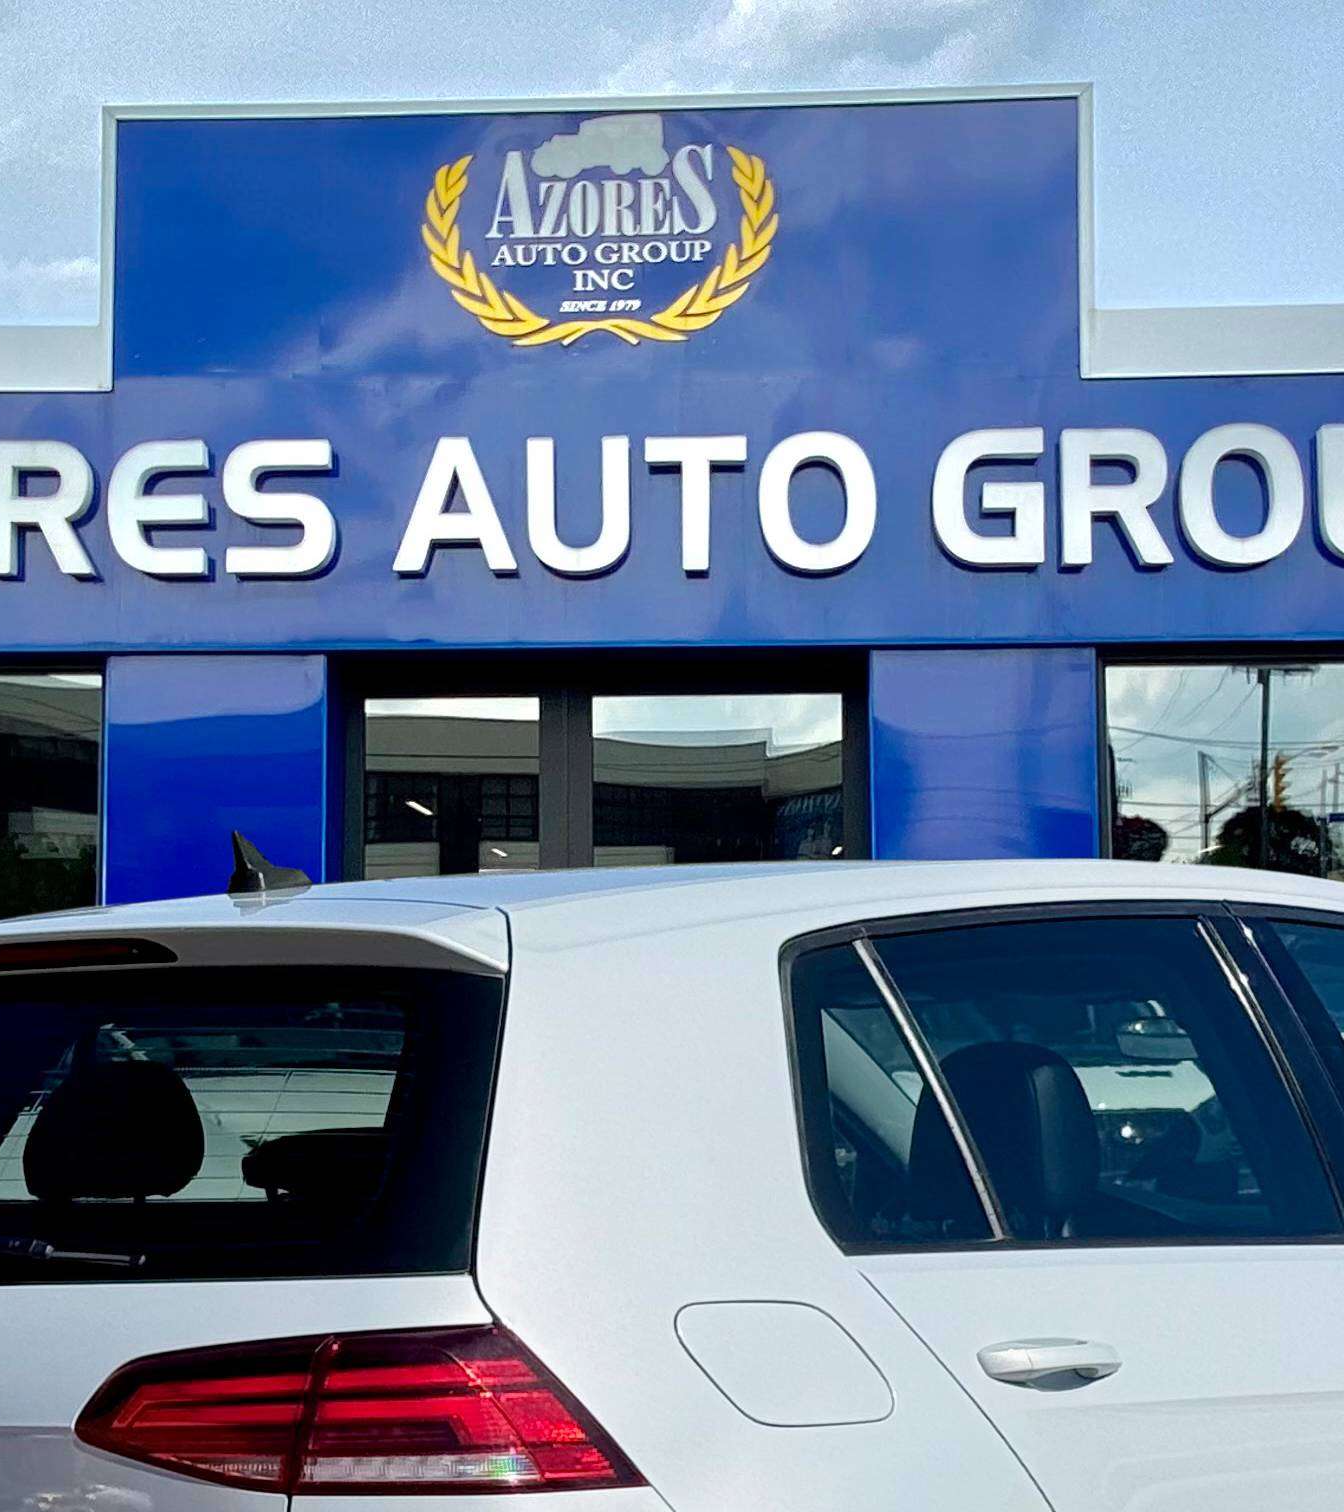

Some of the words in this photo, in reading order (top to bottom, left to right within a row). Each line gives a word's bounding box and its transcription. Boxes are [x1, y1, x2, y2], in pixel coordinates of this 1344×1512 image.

[485, 144, 718, 239] AZORES
[491, 243, 588, 266] AUTO
[594, 239, 712, 264] GROUP
[572, 269, 635, 291] INC
[558, 299, 608, 313] SINCE
[608, 299, 642, 312] 1979
[392, 431, 878, 574] AUTO
